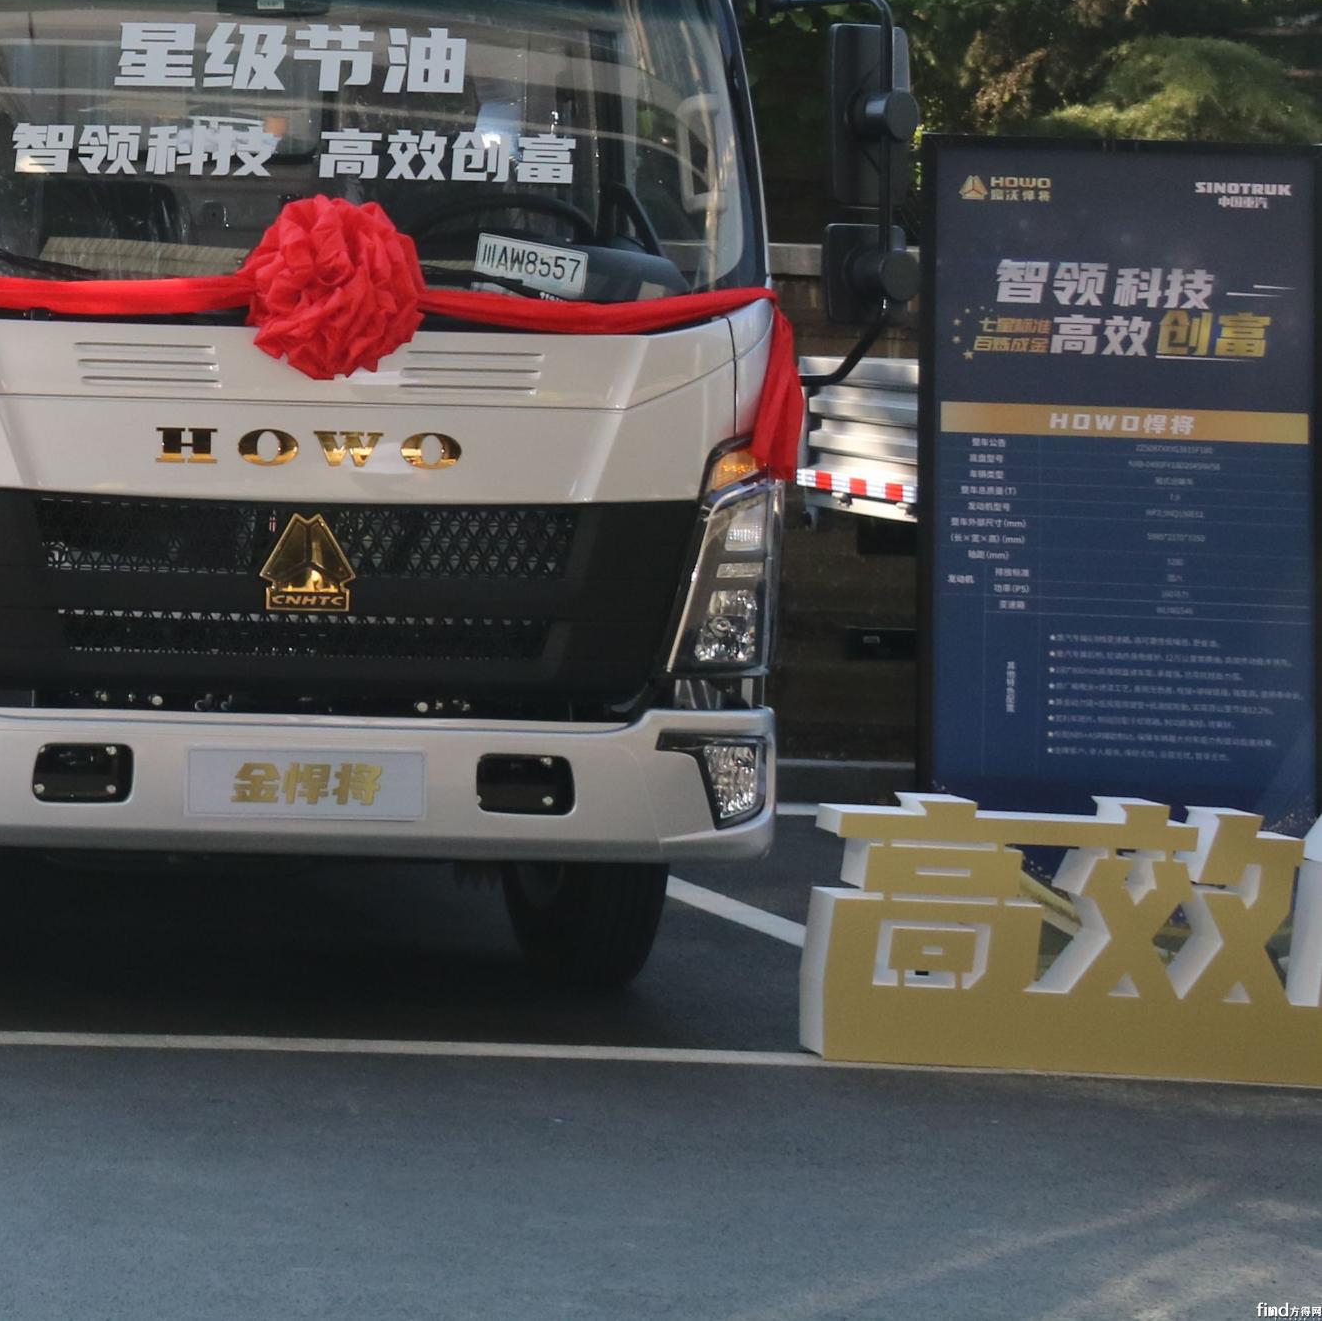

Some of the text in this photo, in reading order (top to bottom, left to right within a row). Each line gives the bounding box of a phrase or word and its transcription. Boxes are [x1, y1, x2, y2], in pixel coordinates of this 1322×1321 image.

[114, 23, 467, 95] 星级节油
[13, 121, 576, 185] 智领科技 高效创富
[990, 176, 1052, 189] HOWO
[1194, 181, 1293, 196] SINOTRUK
[482, 242, 581, 283] 川AW8557
[996, 259, 1216, 309] 智领科技
[1050, 310, 1272, 358] 高效创富
[1049, 412, 1195, 436] HOWO悍将
[155, 426, 462, 469] HOWO
[269, 593, 347, 608] CNHTC
[230, 761, 382, 808] 金悍将
[815, 791, 1322, 1008] 高效
